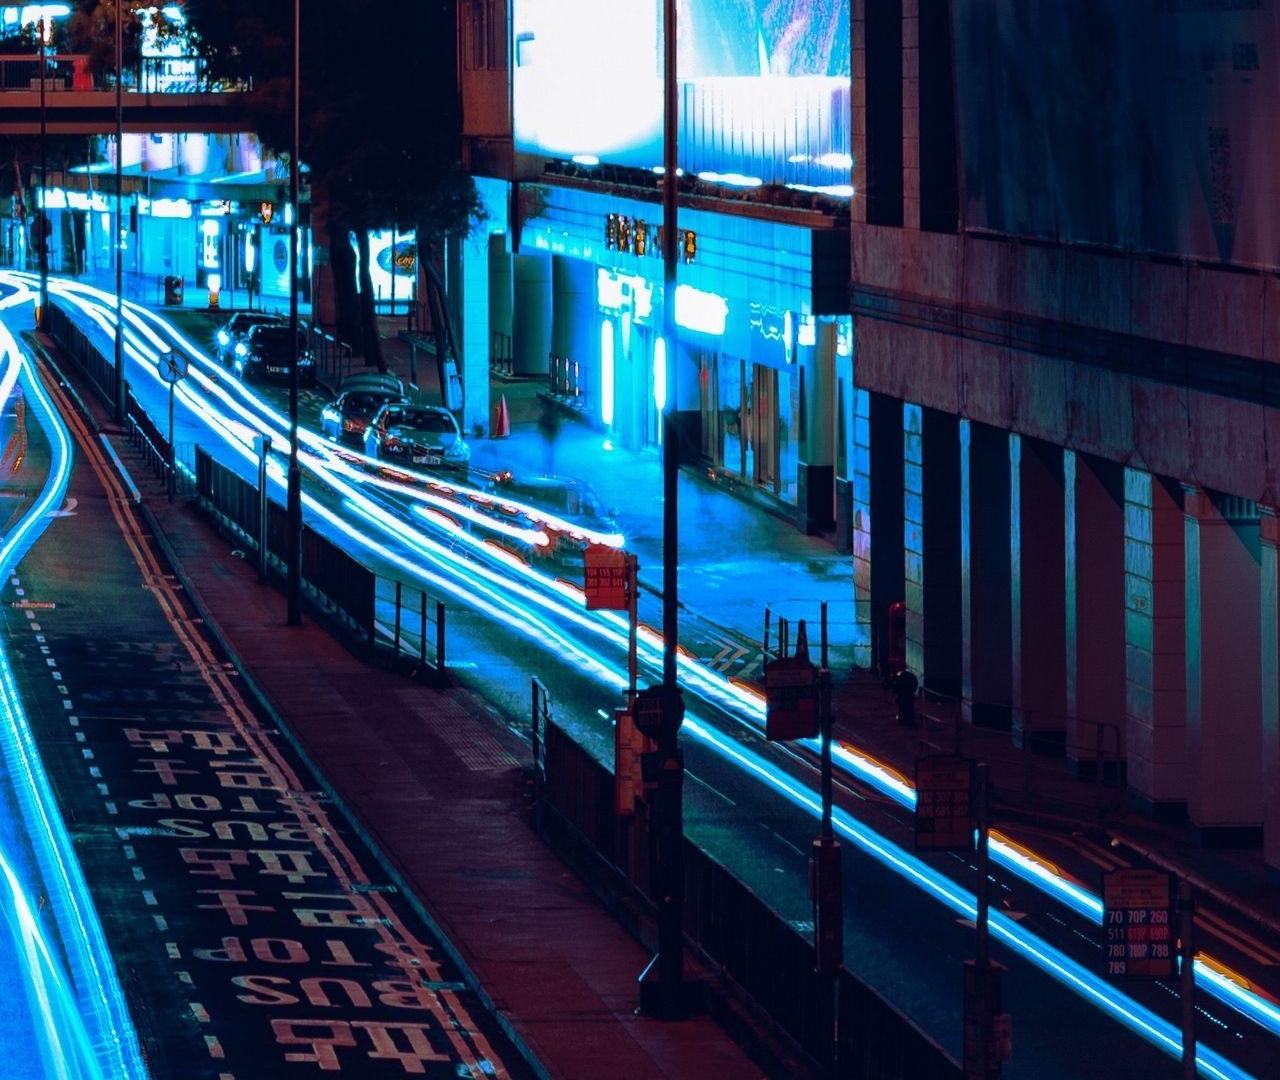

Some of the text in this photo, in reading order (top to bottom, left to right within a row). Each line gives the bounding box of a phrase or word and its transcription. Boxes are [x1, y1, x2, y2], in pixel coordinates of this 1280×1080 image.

[158, 818, 317, 842] BUS
[1108, 910, 1168, 924] 70 70P 260
[193, 936, 441, 969] STOP
[232, 975, 439, 1009] BUS
